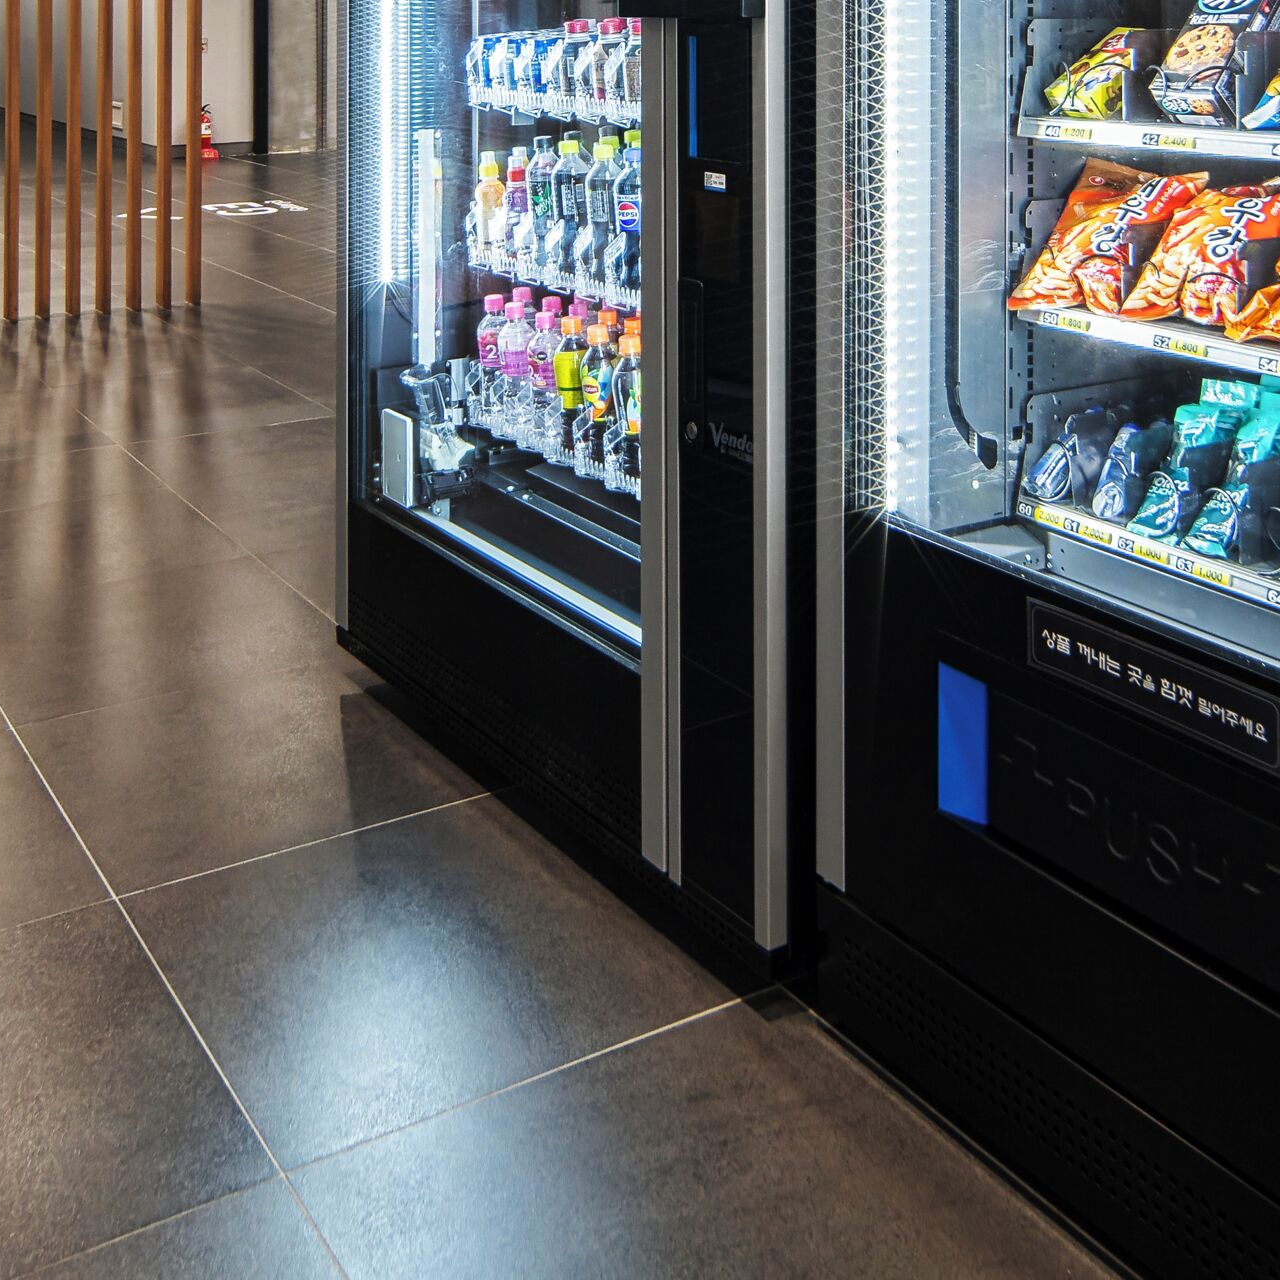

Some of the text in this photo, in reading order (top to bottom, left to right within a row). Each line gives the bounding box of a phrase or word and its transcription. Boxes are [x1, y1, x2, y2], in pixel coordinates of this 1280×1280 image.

[1189, 14, 1219, 25] REAL
[1046, 126, 1059, 136] 40
[1142, 135, 1158, 145] 42
[1043, 313, 1058, 323] 50
[1154, 336, 1169, 347] 52
[1260, 359, 1277, 371] 54
[707, 421, 753, 454] Vendo
[1019, 504, 1031, 515] 60
[1065, 519, 1077, 529] 61
[1118, 538, 1133, 551] 62
[1176, 559, 1192, 572] 63
[1041, 628, 1268, 742] 상품 꺼내는 곳을 힘껏 밀어주세요
